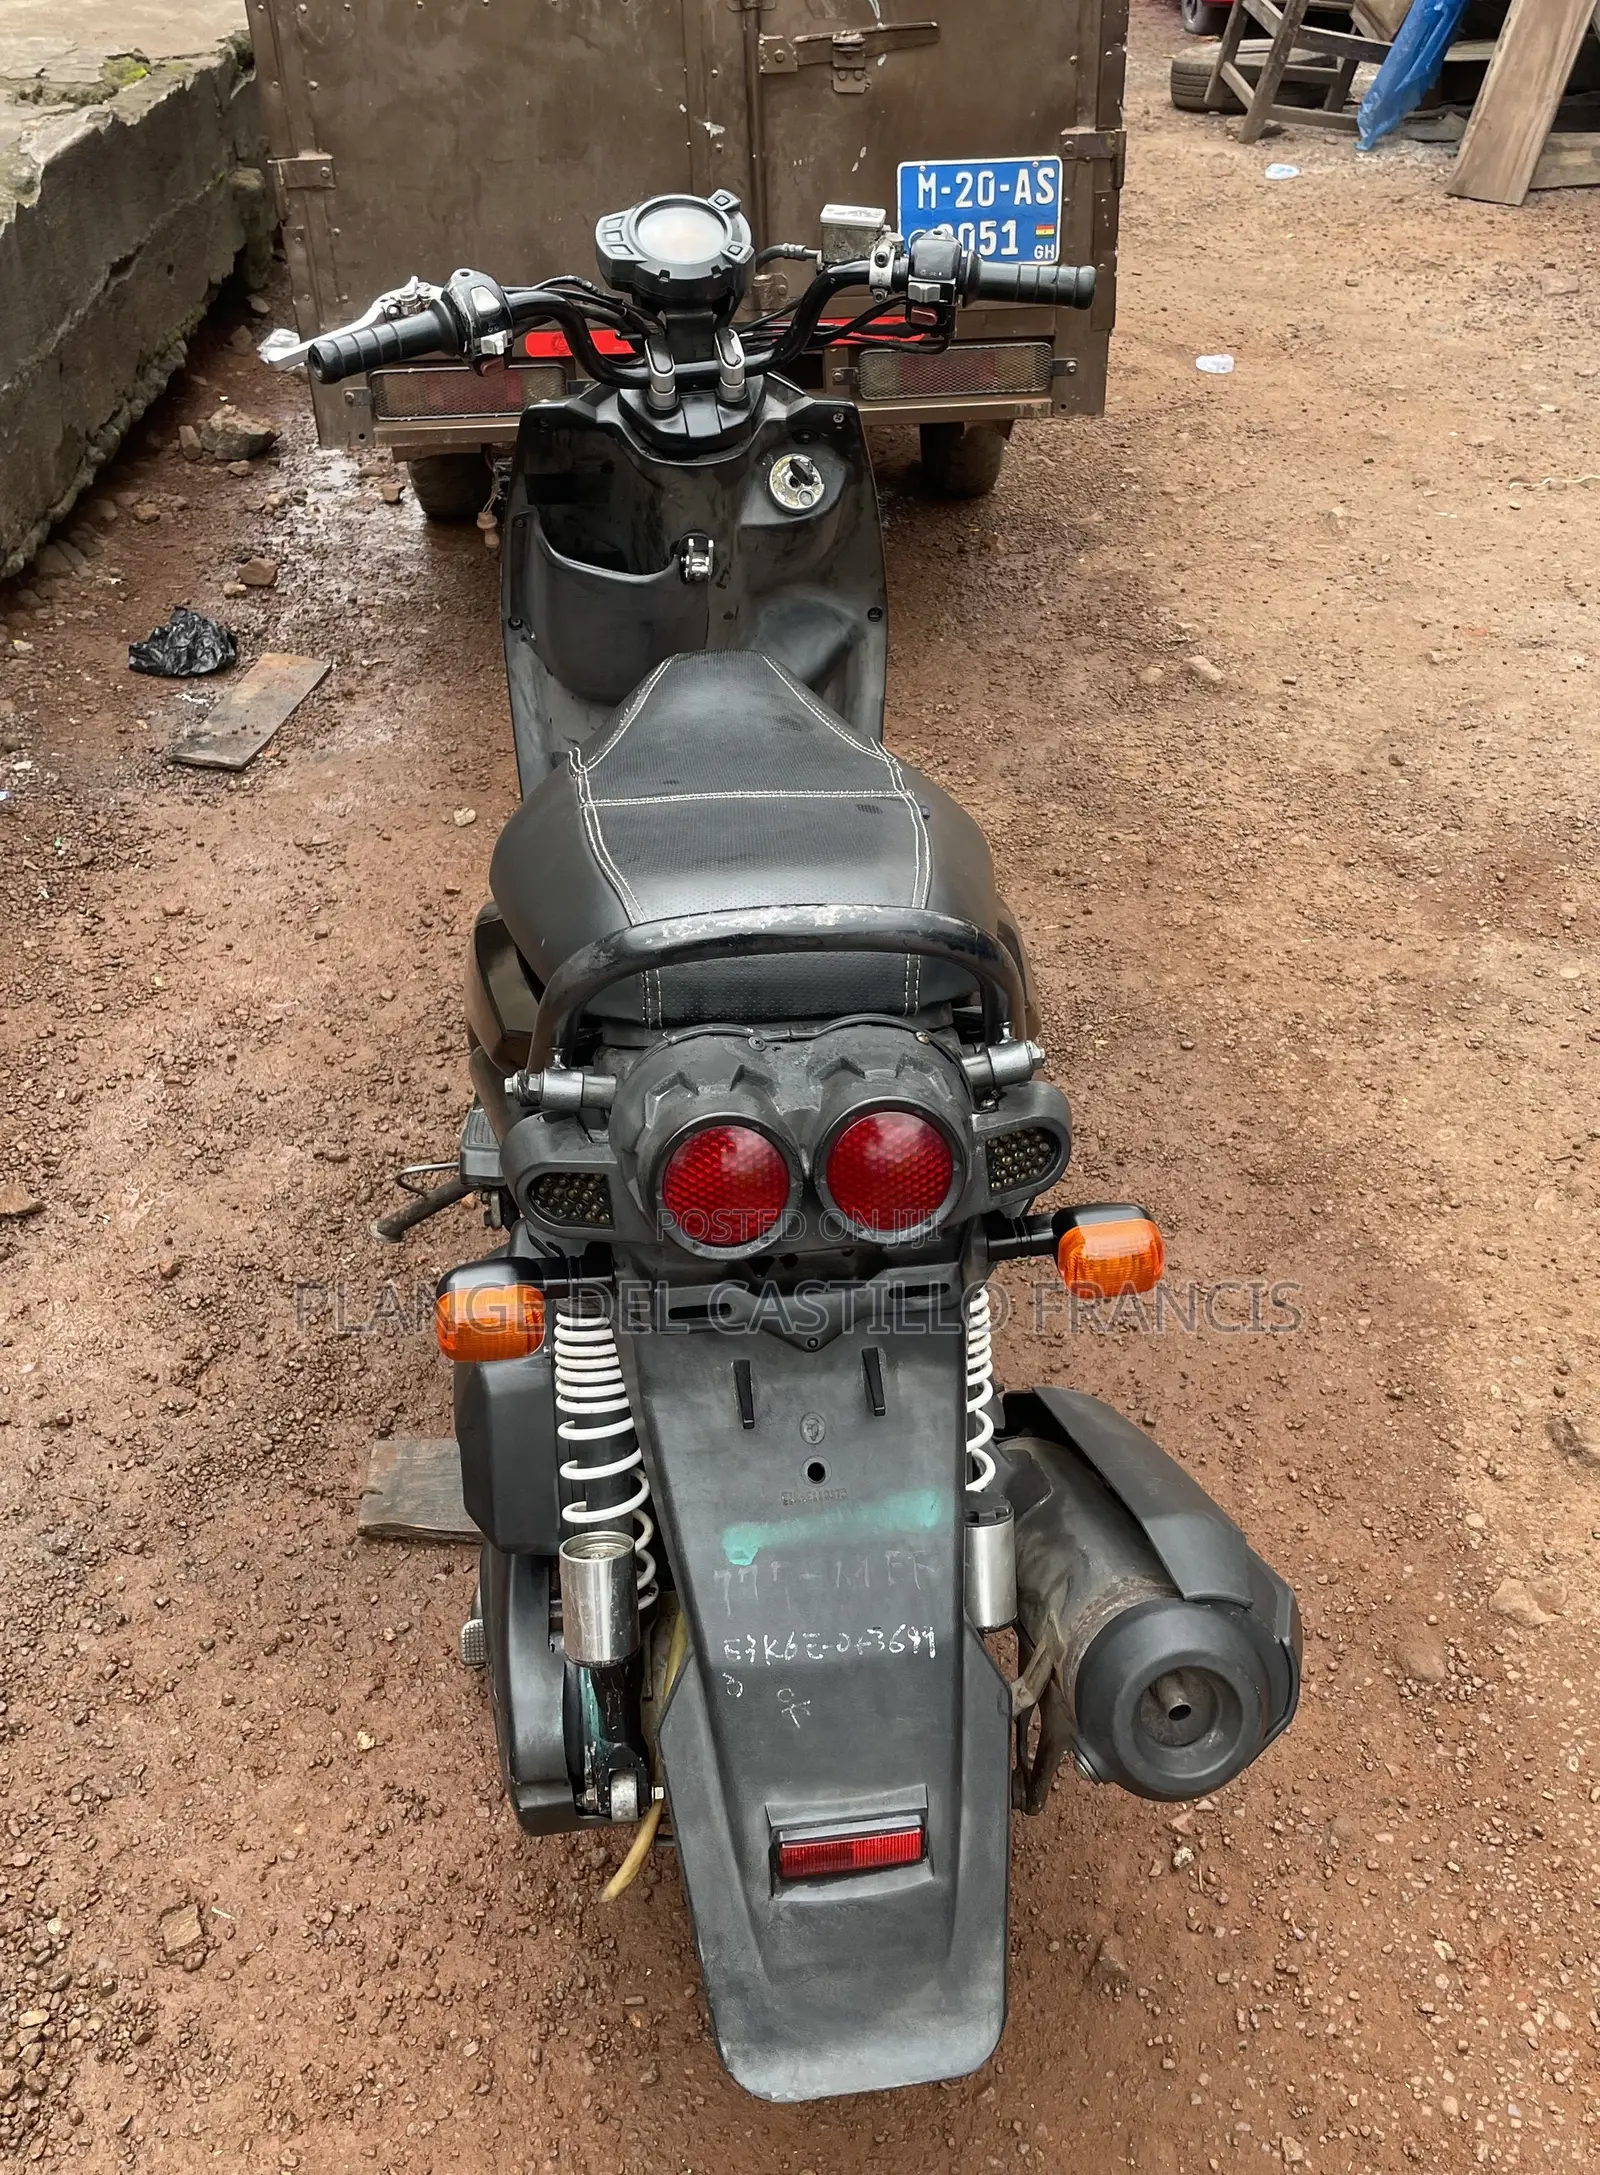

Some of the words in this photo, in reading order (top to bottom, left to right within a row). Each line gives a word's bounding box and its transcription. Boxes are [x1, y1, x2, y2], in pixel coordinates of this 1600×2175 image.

[917, 167, 1055, 209] M-20-AS
[937, 219, 1019, 258] 051
[1033, 244, 1055, 260] GH
